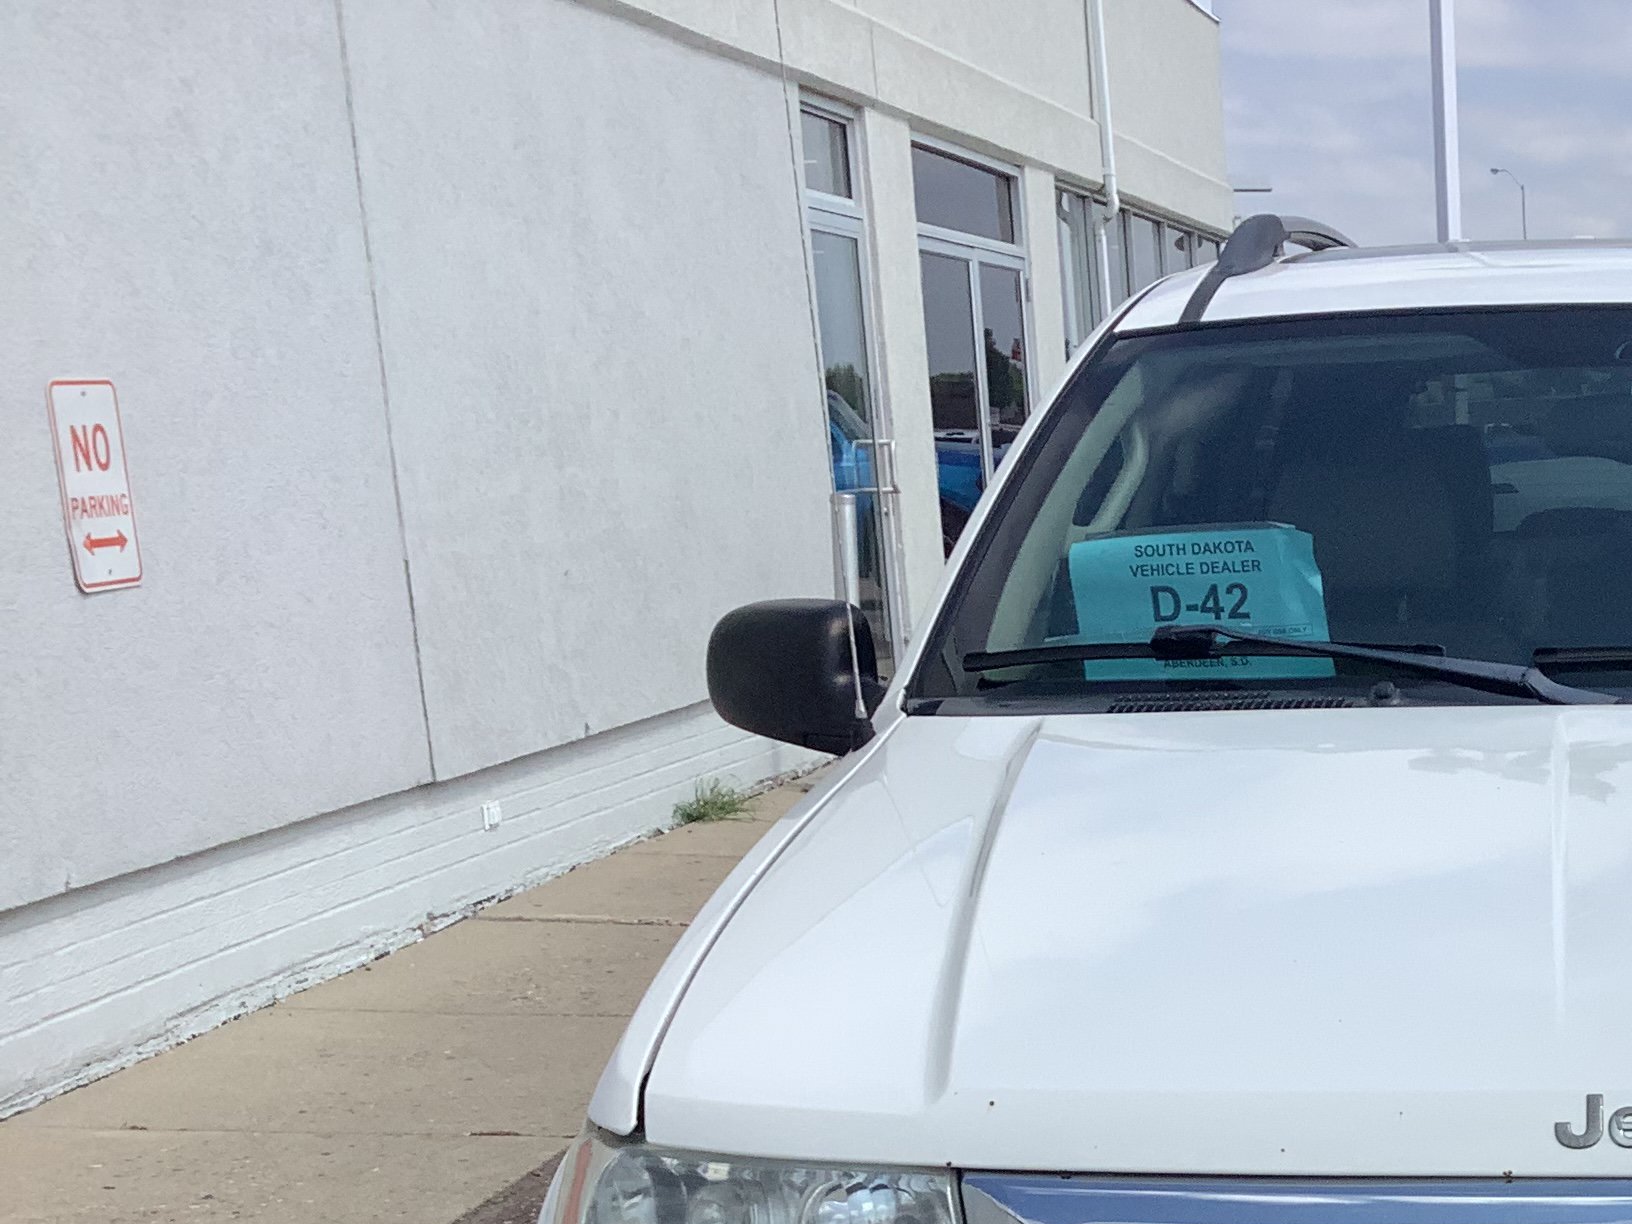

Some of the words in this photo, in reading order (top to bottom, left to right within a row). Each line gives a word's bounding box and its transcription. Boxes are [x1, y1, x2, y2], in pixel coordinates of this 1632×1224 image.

[70, 423, 111, 473] NO
[71, 493, 129, 520] PARKING
[1133, 542, 1187, 558] SOUTH
[1191, 539, 1255, 556] DAKOTA
[1129, 562, 1195, 577] VEHICLE
[1200, 559, 1262, 575] DEALER
[1150, 582, 1251, 622] D-42
